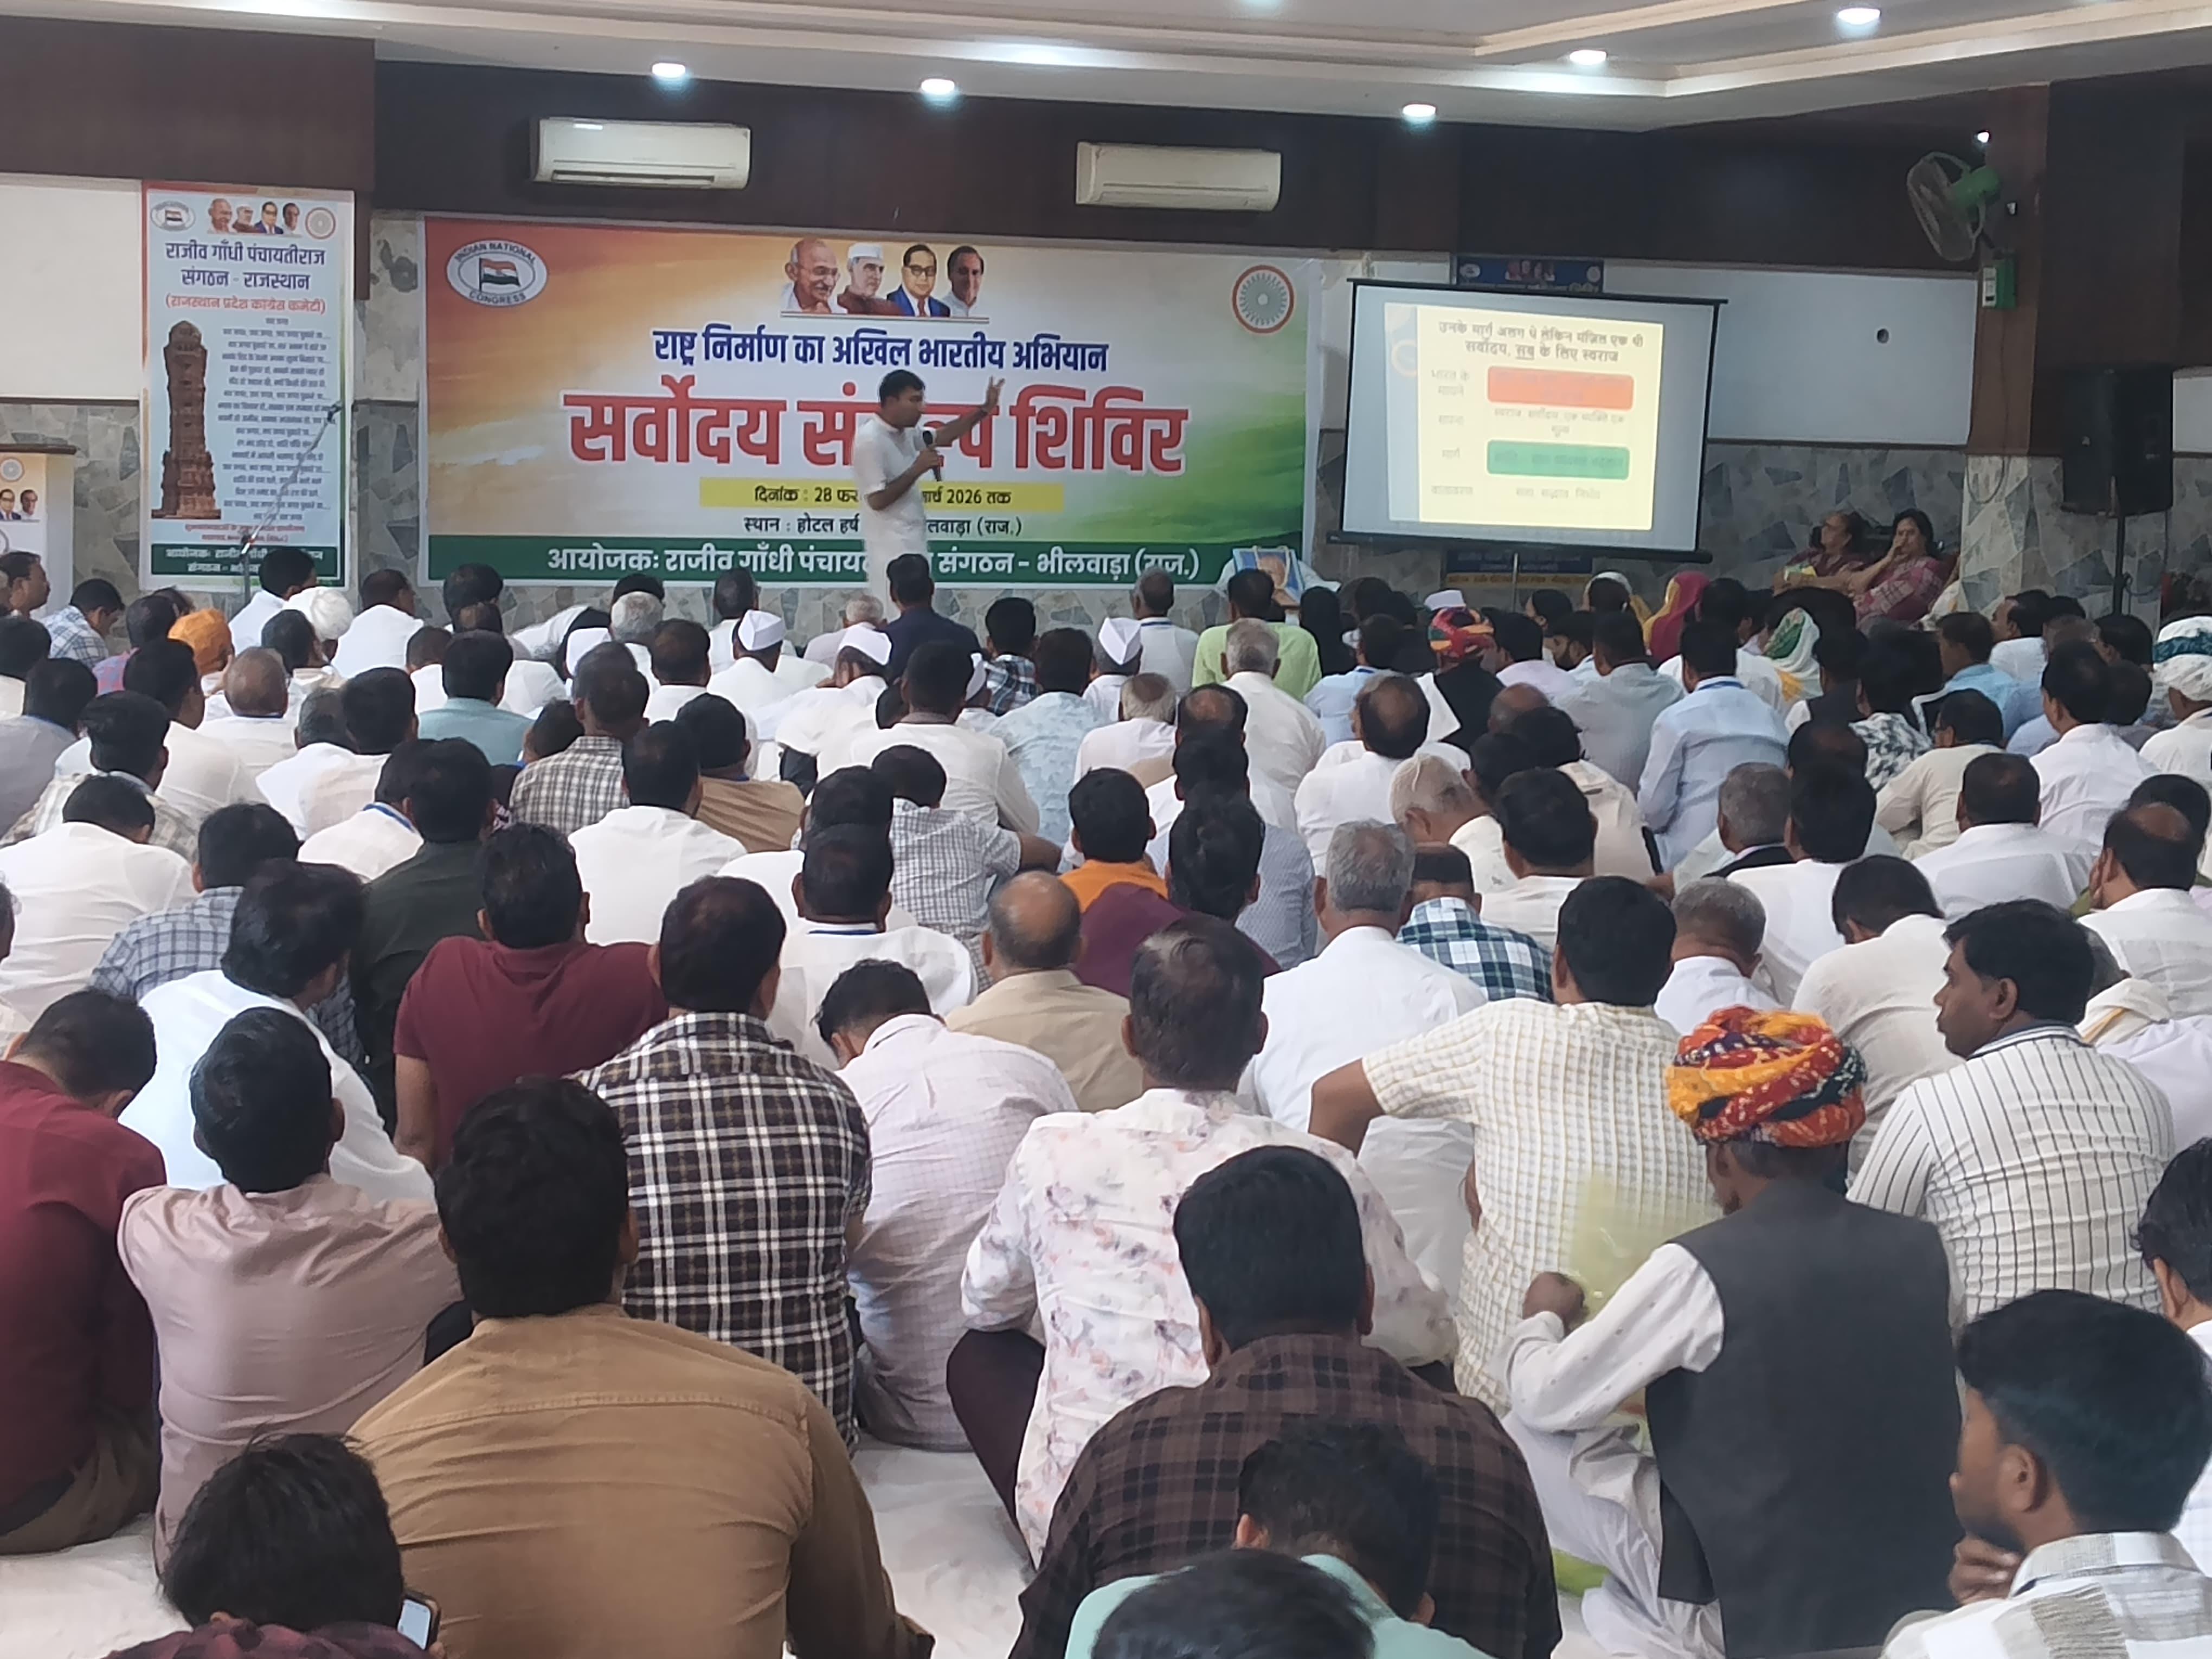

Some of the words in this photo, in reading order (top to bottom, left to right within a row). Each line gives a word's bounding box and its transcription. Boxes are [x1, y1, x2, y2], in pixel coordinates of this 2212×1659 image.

[165, 239, 208, 260] राजीव
[211, 239, 243, 261] गाँधी
[247, 243, 326, 265] पंचायतीराज
[454, 243, 486, 262] INDIAN
[490, 242, 536, 264] NATIONAL
[181, 266, 229, 287] संगठन
[243, 272, 311, 290] राजस्थान
[470, 291, 526, 304] CONGRESS
[653, 331, 697, 365] राष्ट्र
[703, 324, 788, 362] निर्माण
[793, 336, 825, 364] का
[833, 328, 912, 366] अखिल
[919, 331, 1006, 369] भारतीय
[1013, 333, 1109, 372] अभियान
[564, 375, 787, 465] सर्वोदय
[1009, 384, 1189, 472] शिविर
[754, 485, 799, 501] दिनांक
[814, 487, 833, 502] 28
[947, 489, 982, 504] 2026
[987, 491, 1012, 504] तक
[744, 517, 780, 532] स्थान
[798, 512, 834, 533] होटल
[977, 516, 1022, 537] (राज.)
[664, 542, 734, 572] राजीव
[738, 541, 795, 573] गाँधी
[937, 546, 1014, 574] संगठन
[1037, 546, 1131, 581] भीलवाड़ा
